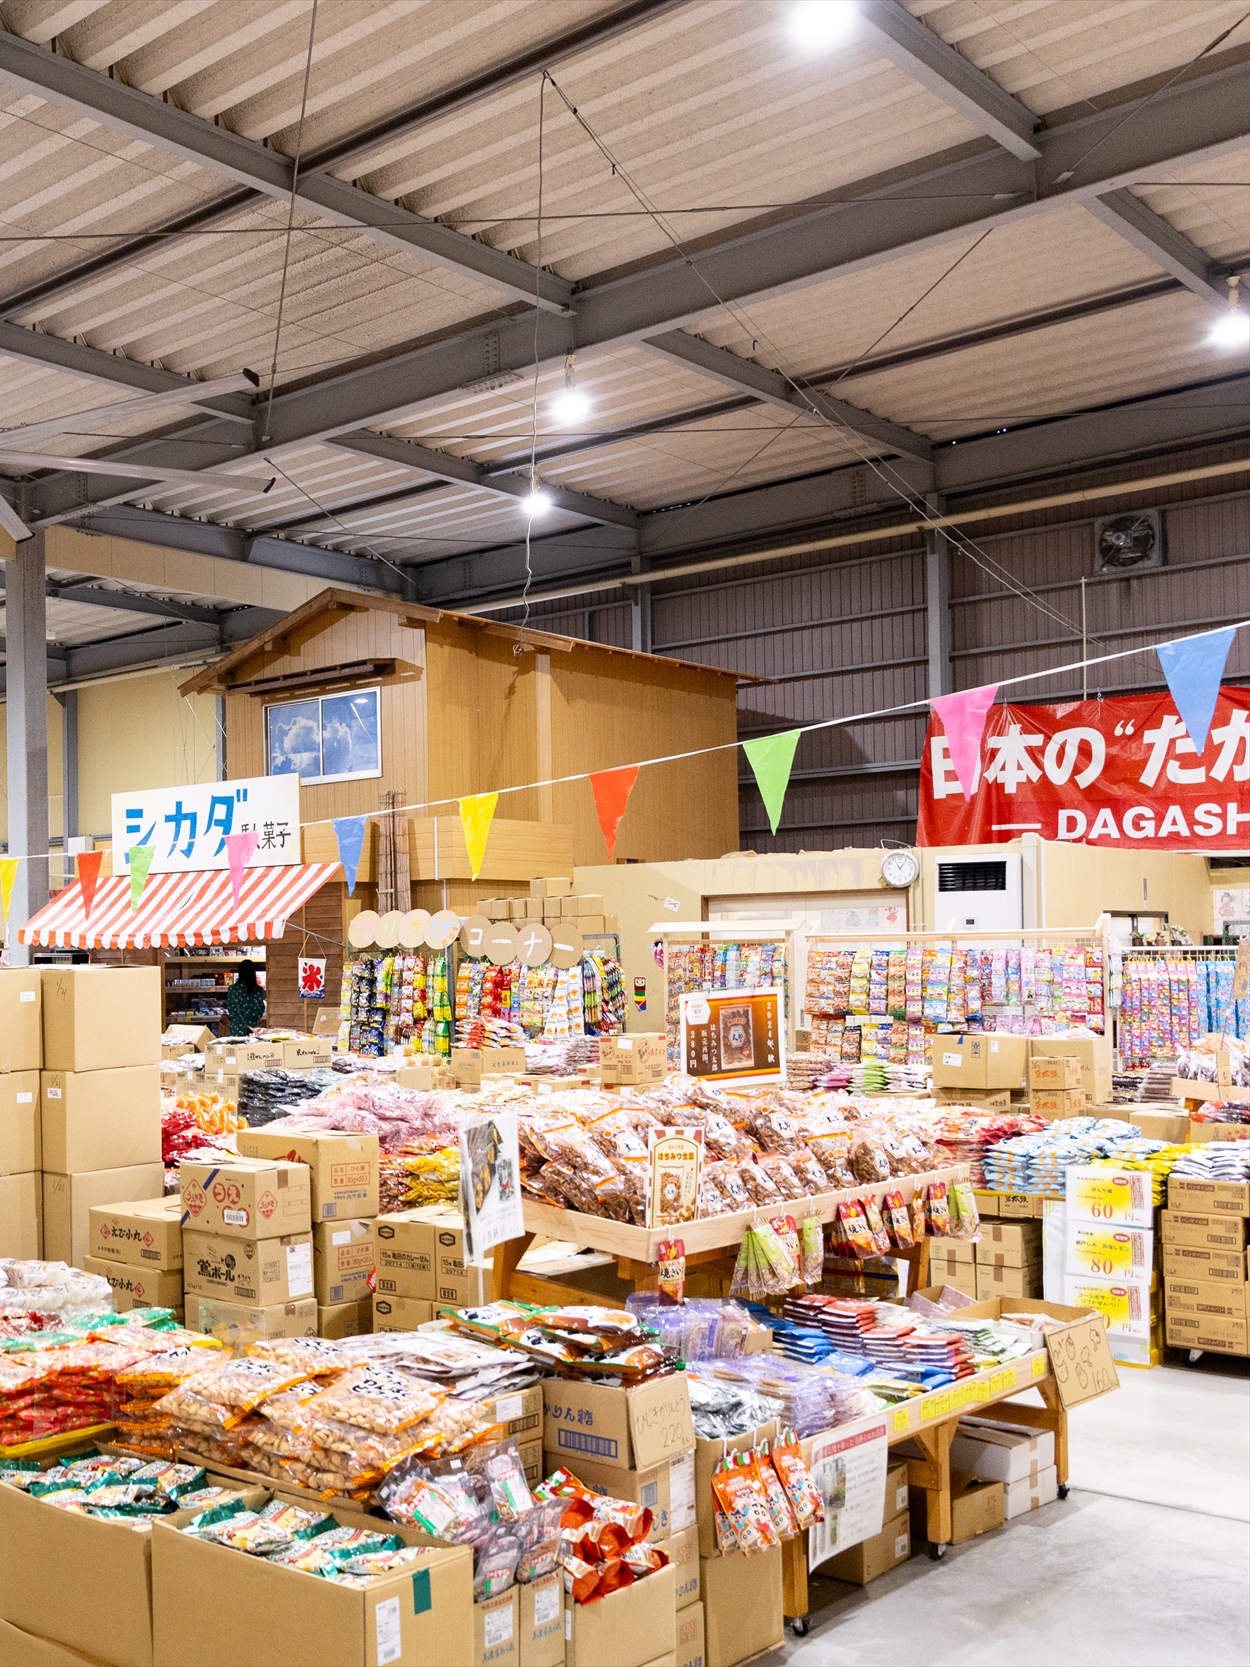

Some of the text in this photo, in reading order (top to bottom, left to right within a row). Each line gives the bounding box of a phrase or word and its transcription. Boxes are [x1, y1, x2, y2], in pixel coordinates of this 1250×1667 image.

[124, 788, 248, 864] シカダ
[355, 918, 454, 942] つりさげ
[469, 928, 574, 958] コーナー
[301, 962, 323, 988] 氷
[710, 1024, 718, 1071] はちみつ太郎
[657, 1152, 694, 1161] はちみつ太郎
[1091, 1202, 1134, 1221] 60 円
[111, 1226, 142, 1242] えび小丸
[392, 1252, 429, 1263] 亀田のカレーせん
[1091, 1257, 1133, 1278] 80 円
[1078, 1293, 1122, 1303] コーンポタージュ
[1081, 1299, 1120, 1308] ソフトせんべい
[1122, 1323, 1132, 1332] 円
